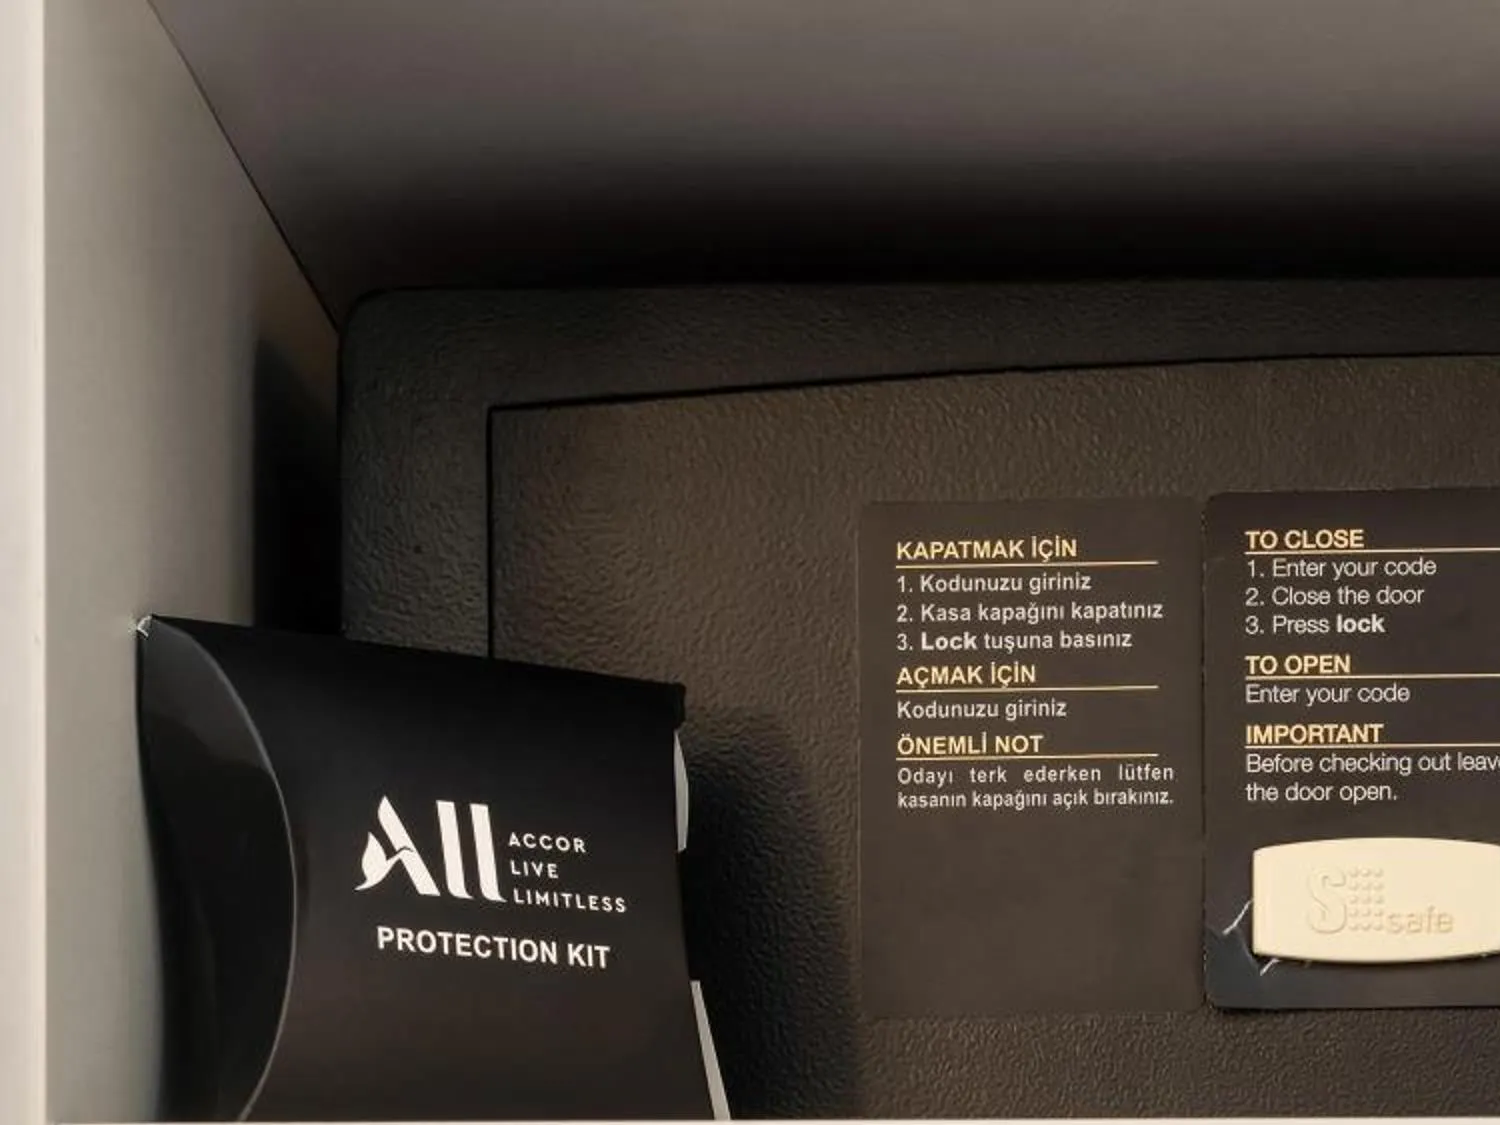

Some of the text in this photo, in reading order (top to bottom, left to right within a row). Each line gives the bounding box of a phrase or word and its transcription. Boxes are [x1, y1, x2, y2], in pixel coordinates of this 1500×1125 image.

[897, 536, 1077, 563] KAPATMAK İÇİN
[1245, 529, 1364, 549] TO CLOSE
[1248, 557, 1436, 580] 1. Enter your code
[898, 573, 1091, 594] 1. Kodunuzu giriniz
[1245, 586, 1424, 606] 2. Close the door
[897, 602, 1163, 624] 2. Kasa kapağını kapatınız
[1245, 614, 1385, 634] 3. Press lock
[897, 631, 1132, 653] 3. Lock tuşuna basınız
[897, 662, 1035, 688] AÇMAK İÇİN
[1245, 655, 1350, 674] TO OPEN
[1246, 684, 1410, 706] Enter your code
[897, 699, 1067, 721] Kodunuzu giriniz
[897, 732, 1043, 755] ÖNEMLİ NOT
[1247, 724, 1384, 743] IMPORTANT
[1246, 755, 1312, 773] Before
[1319, 753, 1412, 775] checking
[1418, 755, 1451, 771] out
[898, 764, 1174, 788] Odayı terk ederken lütfen
[898, 788, 1173, 810] kasanın kapağını açık bırakınız.
[1246, 783, 1397, 804] the door open.
[508, 831, 587, 854] ACCOR
[510, 861, 558, 880] LIVE
[513, 888, 627, 913] LIMITLESS
[377, 926, 611, 969] PROTECTION KIT
